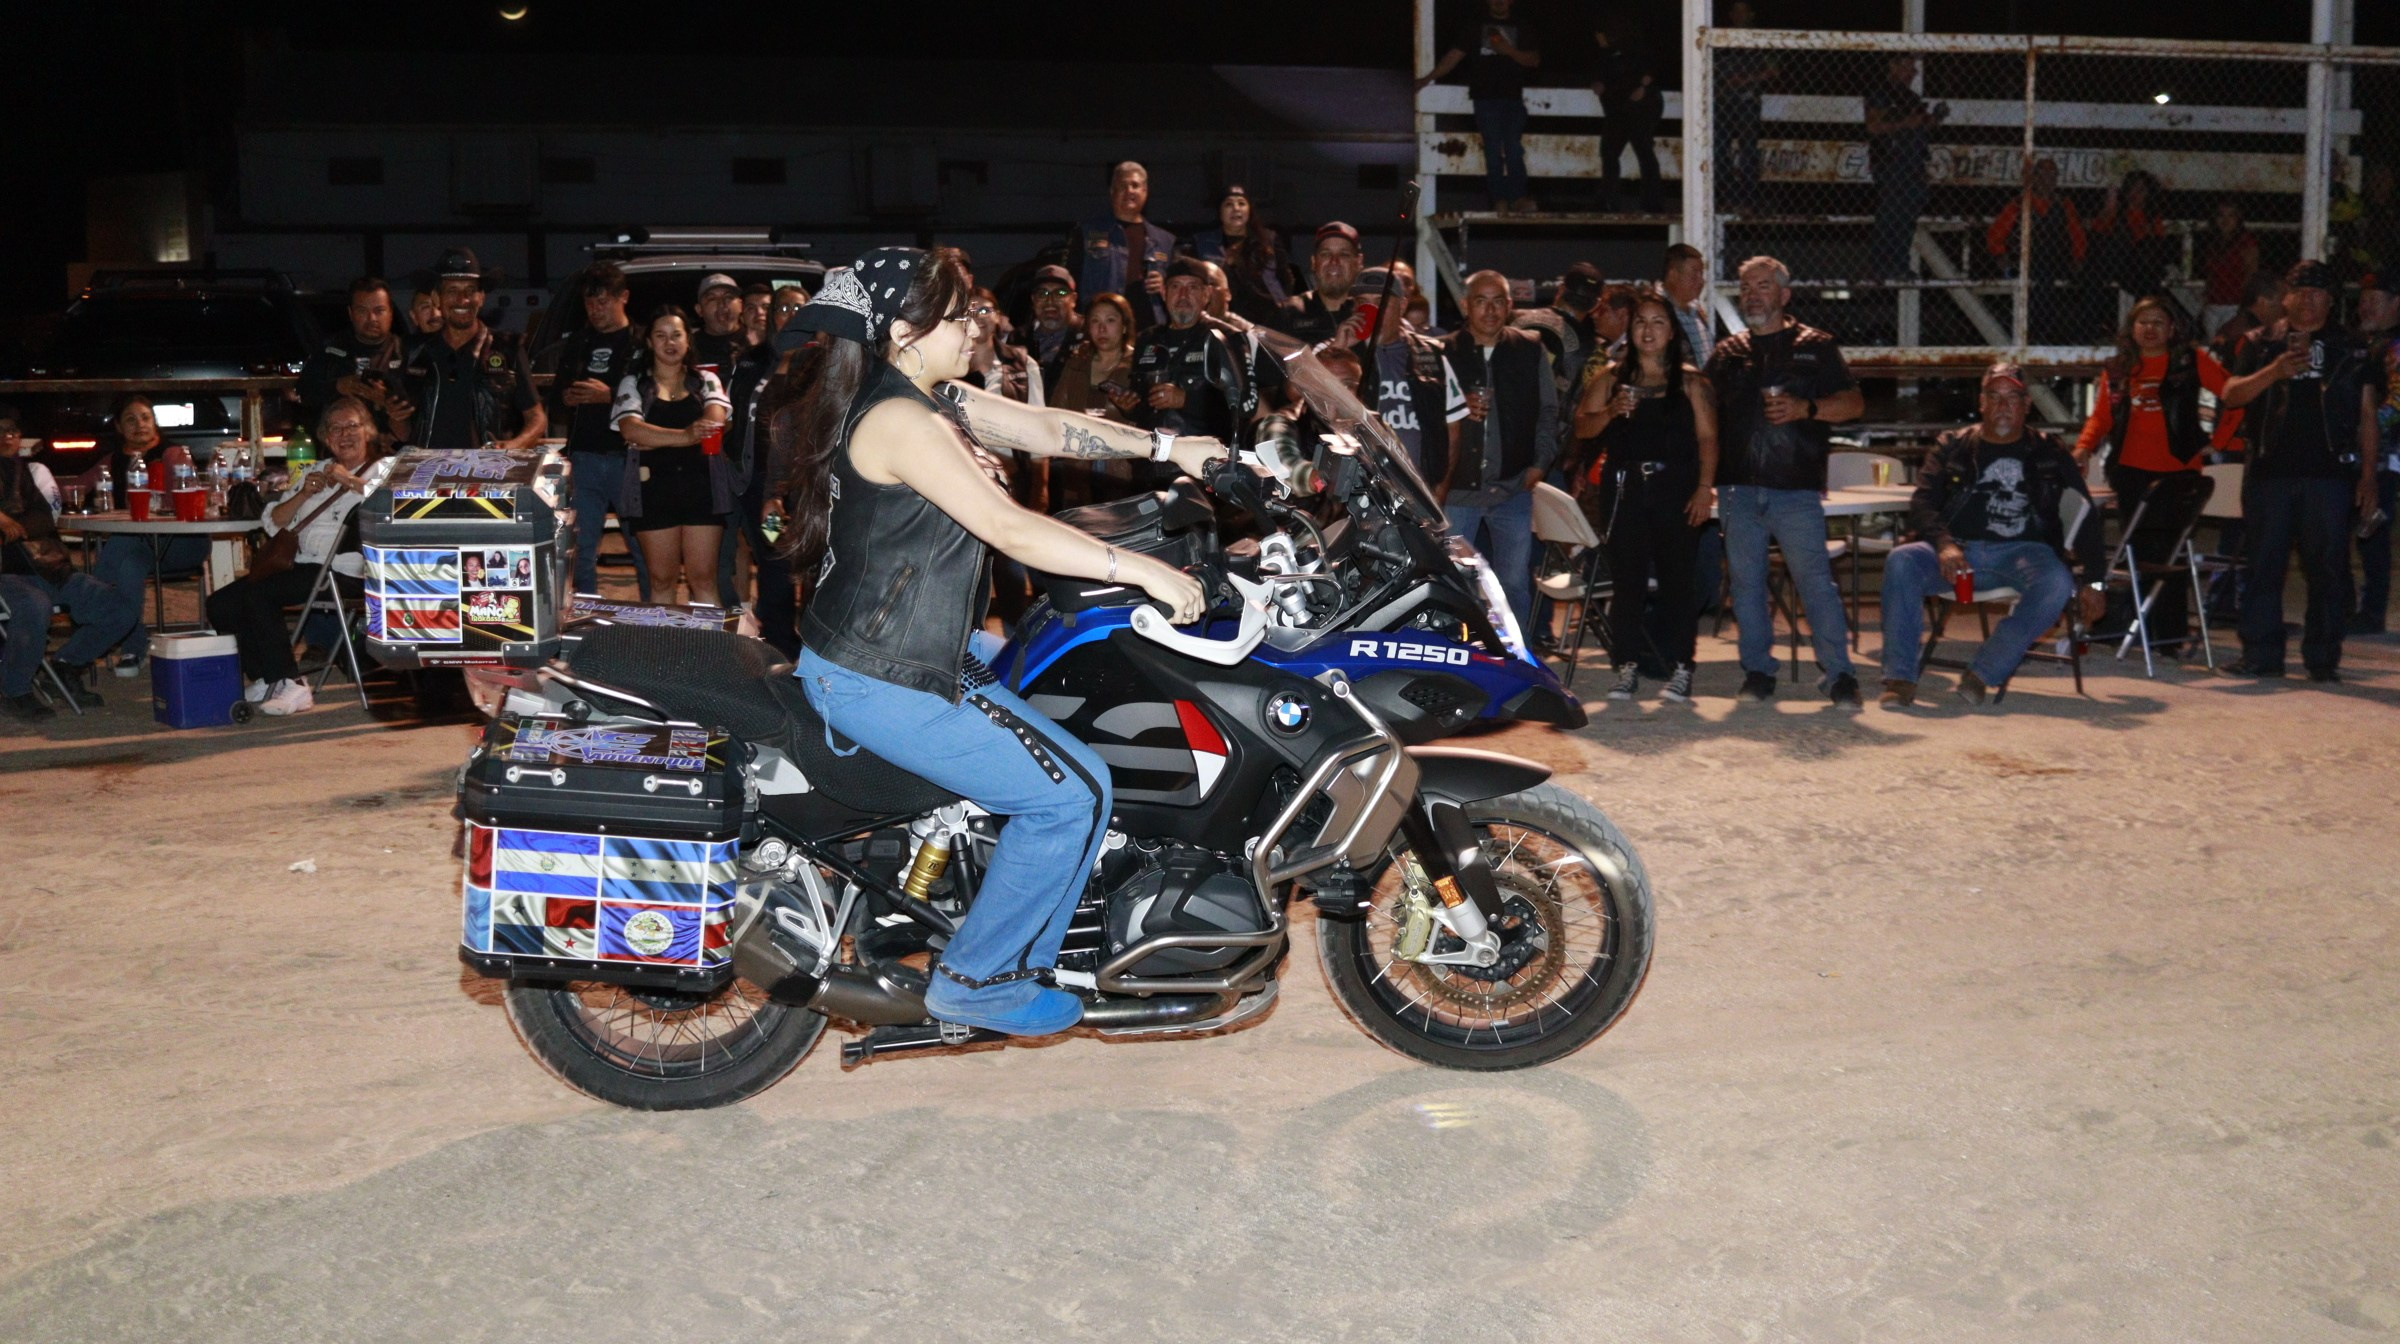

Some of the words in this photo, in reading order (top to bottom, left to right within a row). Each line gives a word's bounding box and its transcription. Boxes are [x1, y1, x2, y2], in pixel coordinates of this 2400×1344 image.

[1350, 640, 1378, 658] R
[1383, 641, 1469, 666] 1250
[587, 751, 704, 768] ADVENTURE
